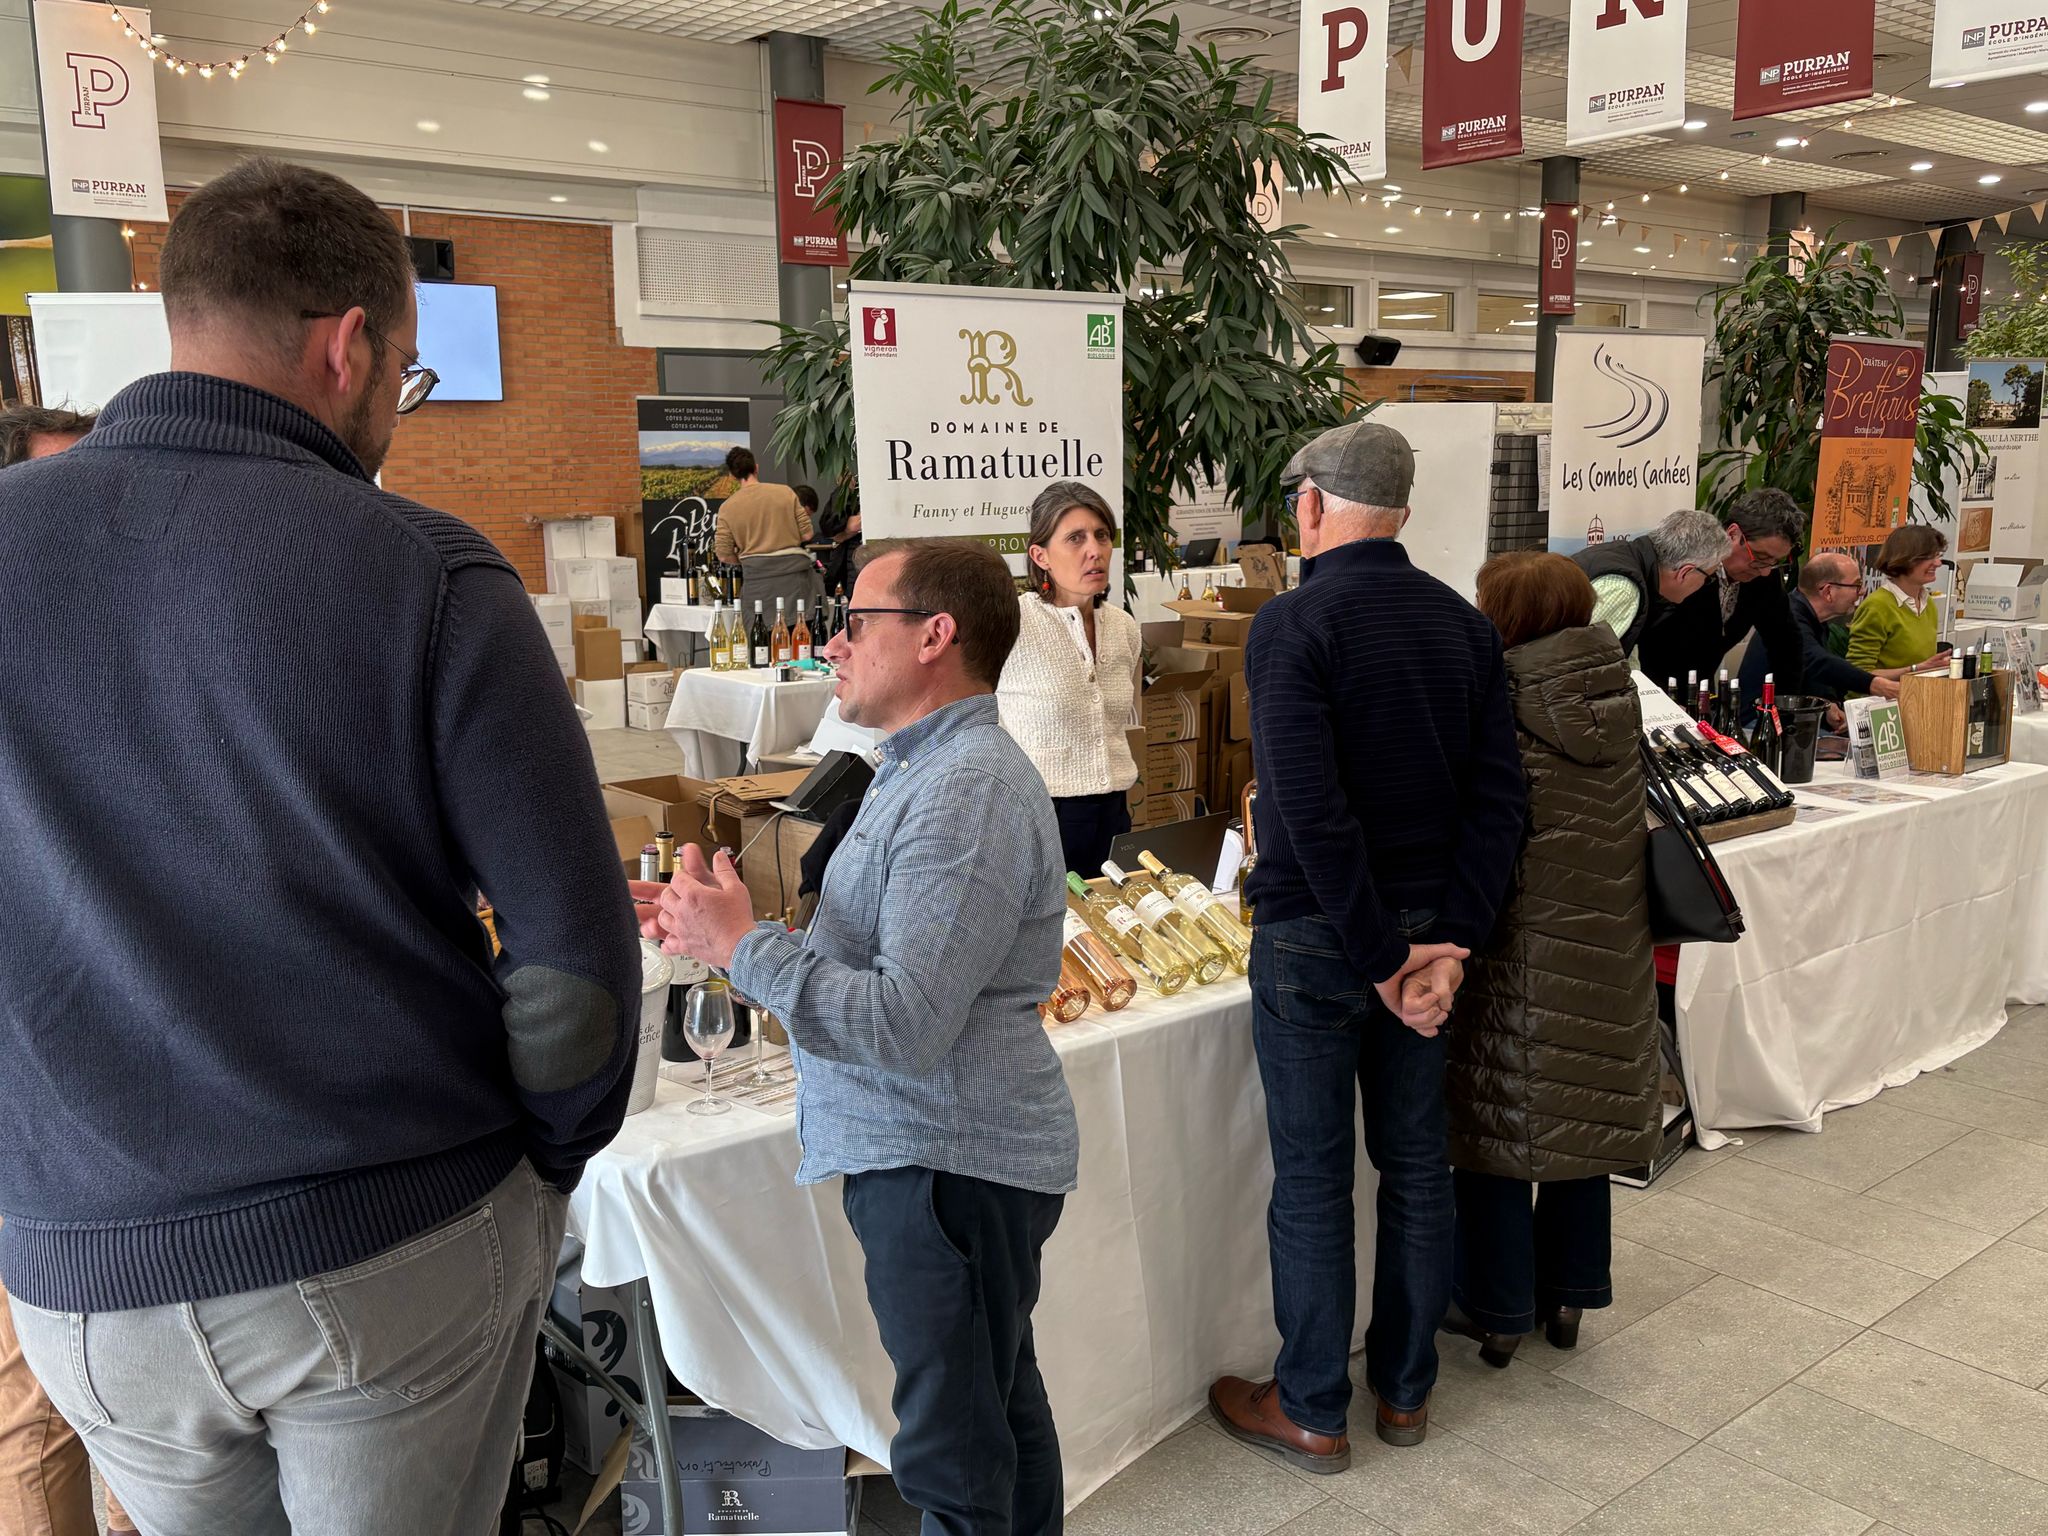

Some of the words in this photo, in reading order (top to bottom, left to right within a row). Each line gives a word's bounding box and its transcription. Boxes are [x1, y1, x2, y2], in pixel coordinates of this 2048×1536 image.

[1451, 0, 1502, 62] U
[1989, 17, 2048, 39] PURPA
[2014, 32, 2048, 42] D'INGÉNI
[1321, 7, 1368, 93] P
[1783, 51, 1850, 76] PURPAN
[1761, 68, 1780, 80] INP
[66, 52, 129, 129] P
[82, 86, 92, 115] PURPAN
[1608, 83, 1665, 105] PURPAN
[1457, 115, 1507, 134] PURPAN
[793, 140, 830, 198] P
[92, 180, 146, 194] PURPAN
[805, 236, 838, 246] PURPAN
[1552, 229, 1570, 269] P
[1089, 324, 1111, 347] AB
[665, 414, 683, 422] CÔTES
[671, 422, 688, 430] CÔTES
[930, 421, 1028, 434] DOMAINE
[1039, 421, 1059, 434] DE
[885, 439, 1103, 481] Ramatuelle
[1562, 463, 1583, 491] Les
[1589, 458, 1638, 492] Combes
[1643, 455, 1691, 489] Cachées
[913, 504, 958, 522] Fanny
[963, 505, 975, 517] et
[981, 502, 1031, 520] Hugues
[989, 537, 1030, 552] PROV
[1878, 721, 1900, 752] AB
[1878, 751, 1906, 762] AGRICULTURE
[639, 1029, 661, 1045] ence
[645, 1023, 655, 1035] de
[707, 1513, 760, 1521] Ramatuelle
